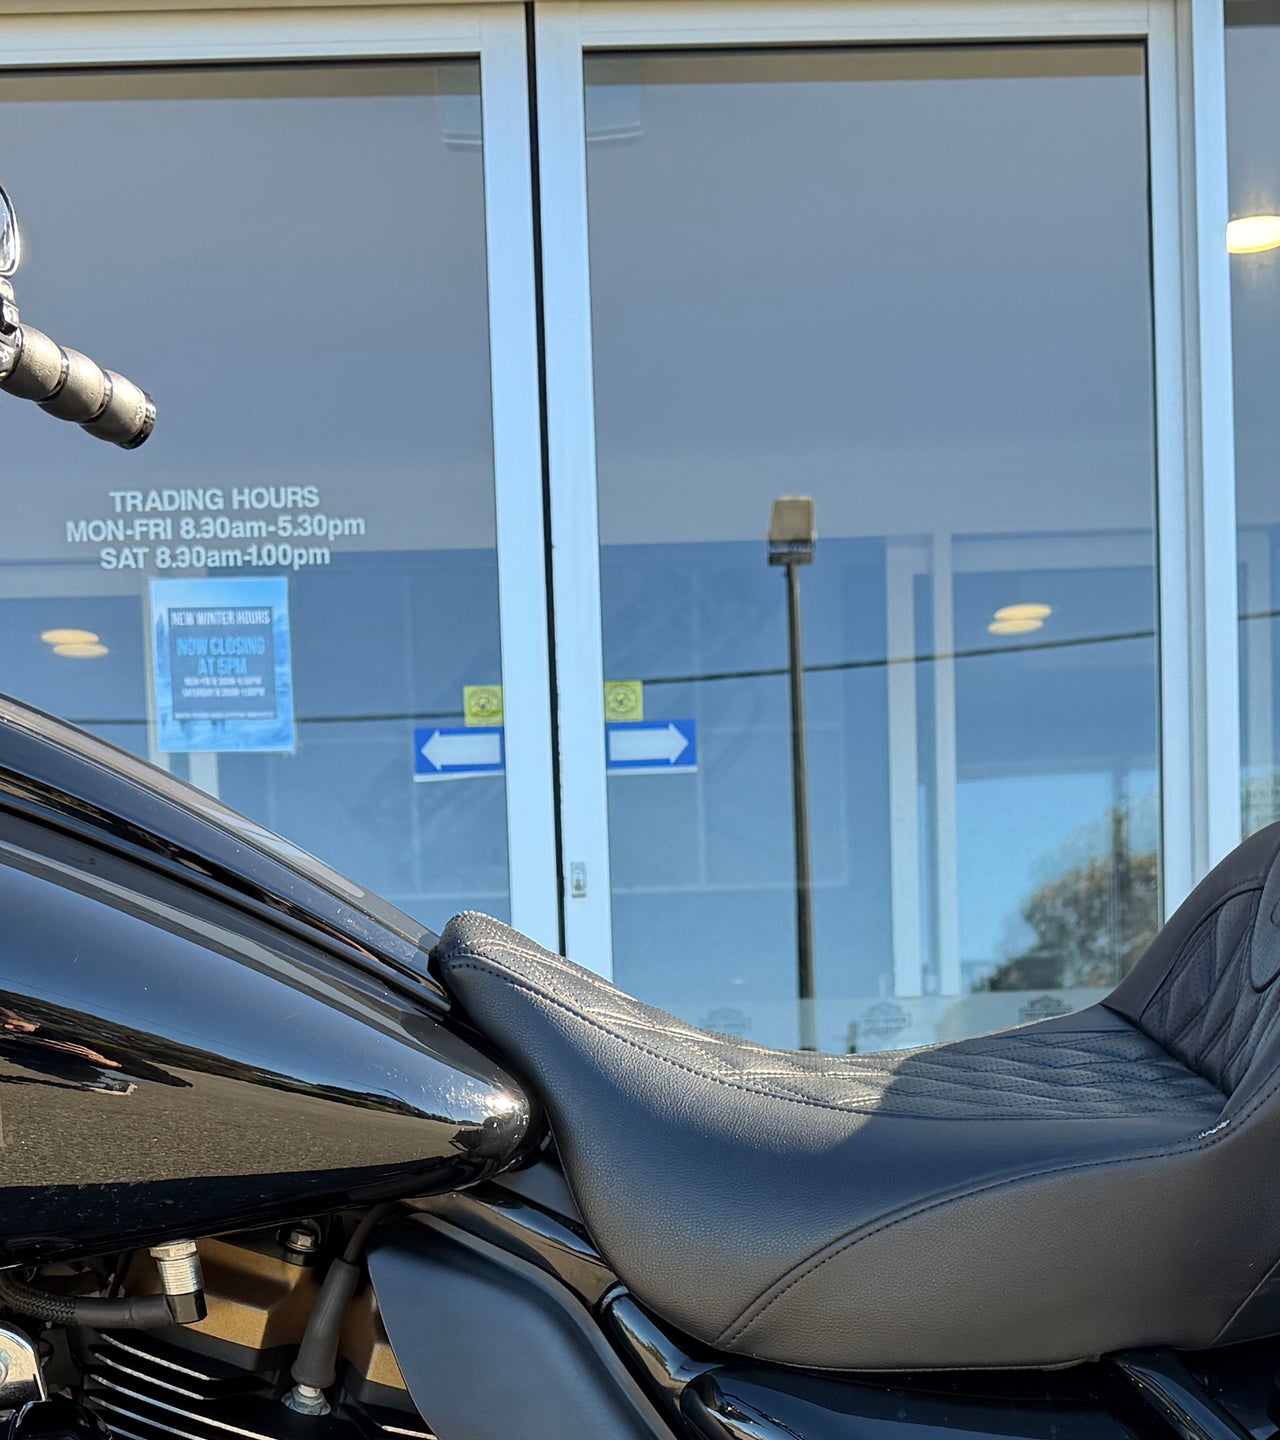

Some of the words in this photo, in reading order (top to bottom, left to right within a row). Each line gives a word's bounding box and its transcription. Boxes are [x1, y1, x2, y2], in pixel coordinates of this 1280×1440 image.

[109, 488, 224, 513] TRADING
[231, 486, 320, 510] HOURS
[65, 518, 173, 543] MON-FRI
[179, 515, 366, 541] 8.30am-5.30pm
[99, 547, 148, 570] SAT
[155, 544, 331, 570] 8.30am-1.00pm
[170, 611, 195, 626] NEW
[235, 609, 271, 625] HOURS
[176, 637, 208, 656] NOW
[208, 636, 265, 656] CLOSING
